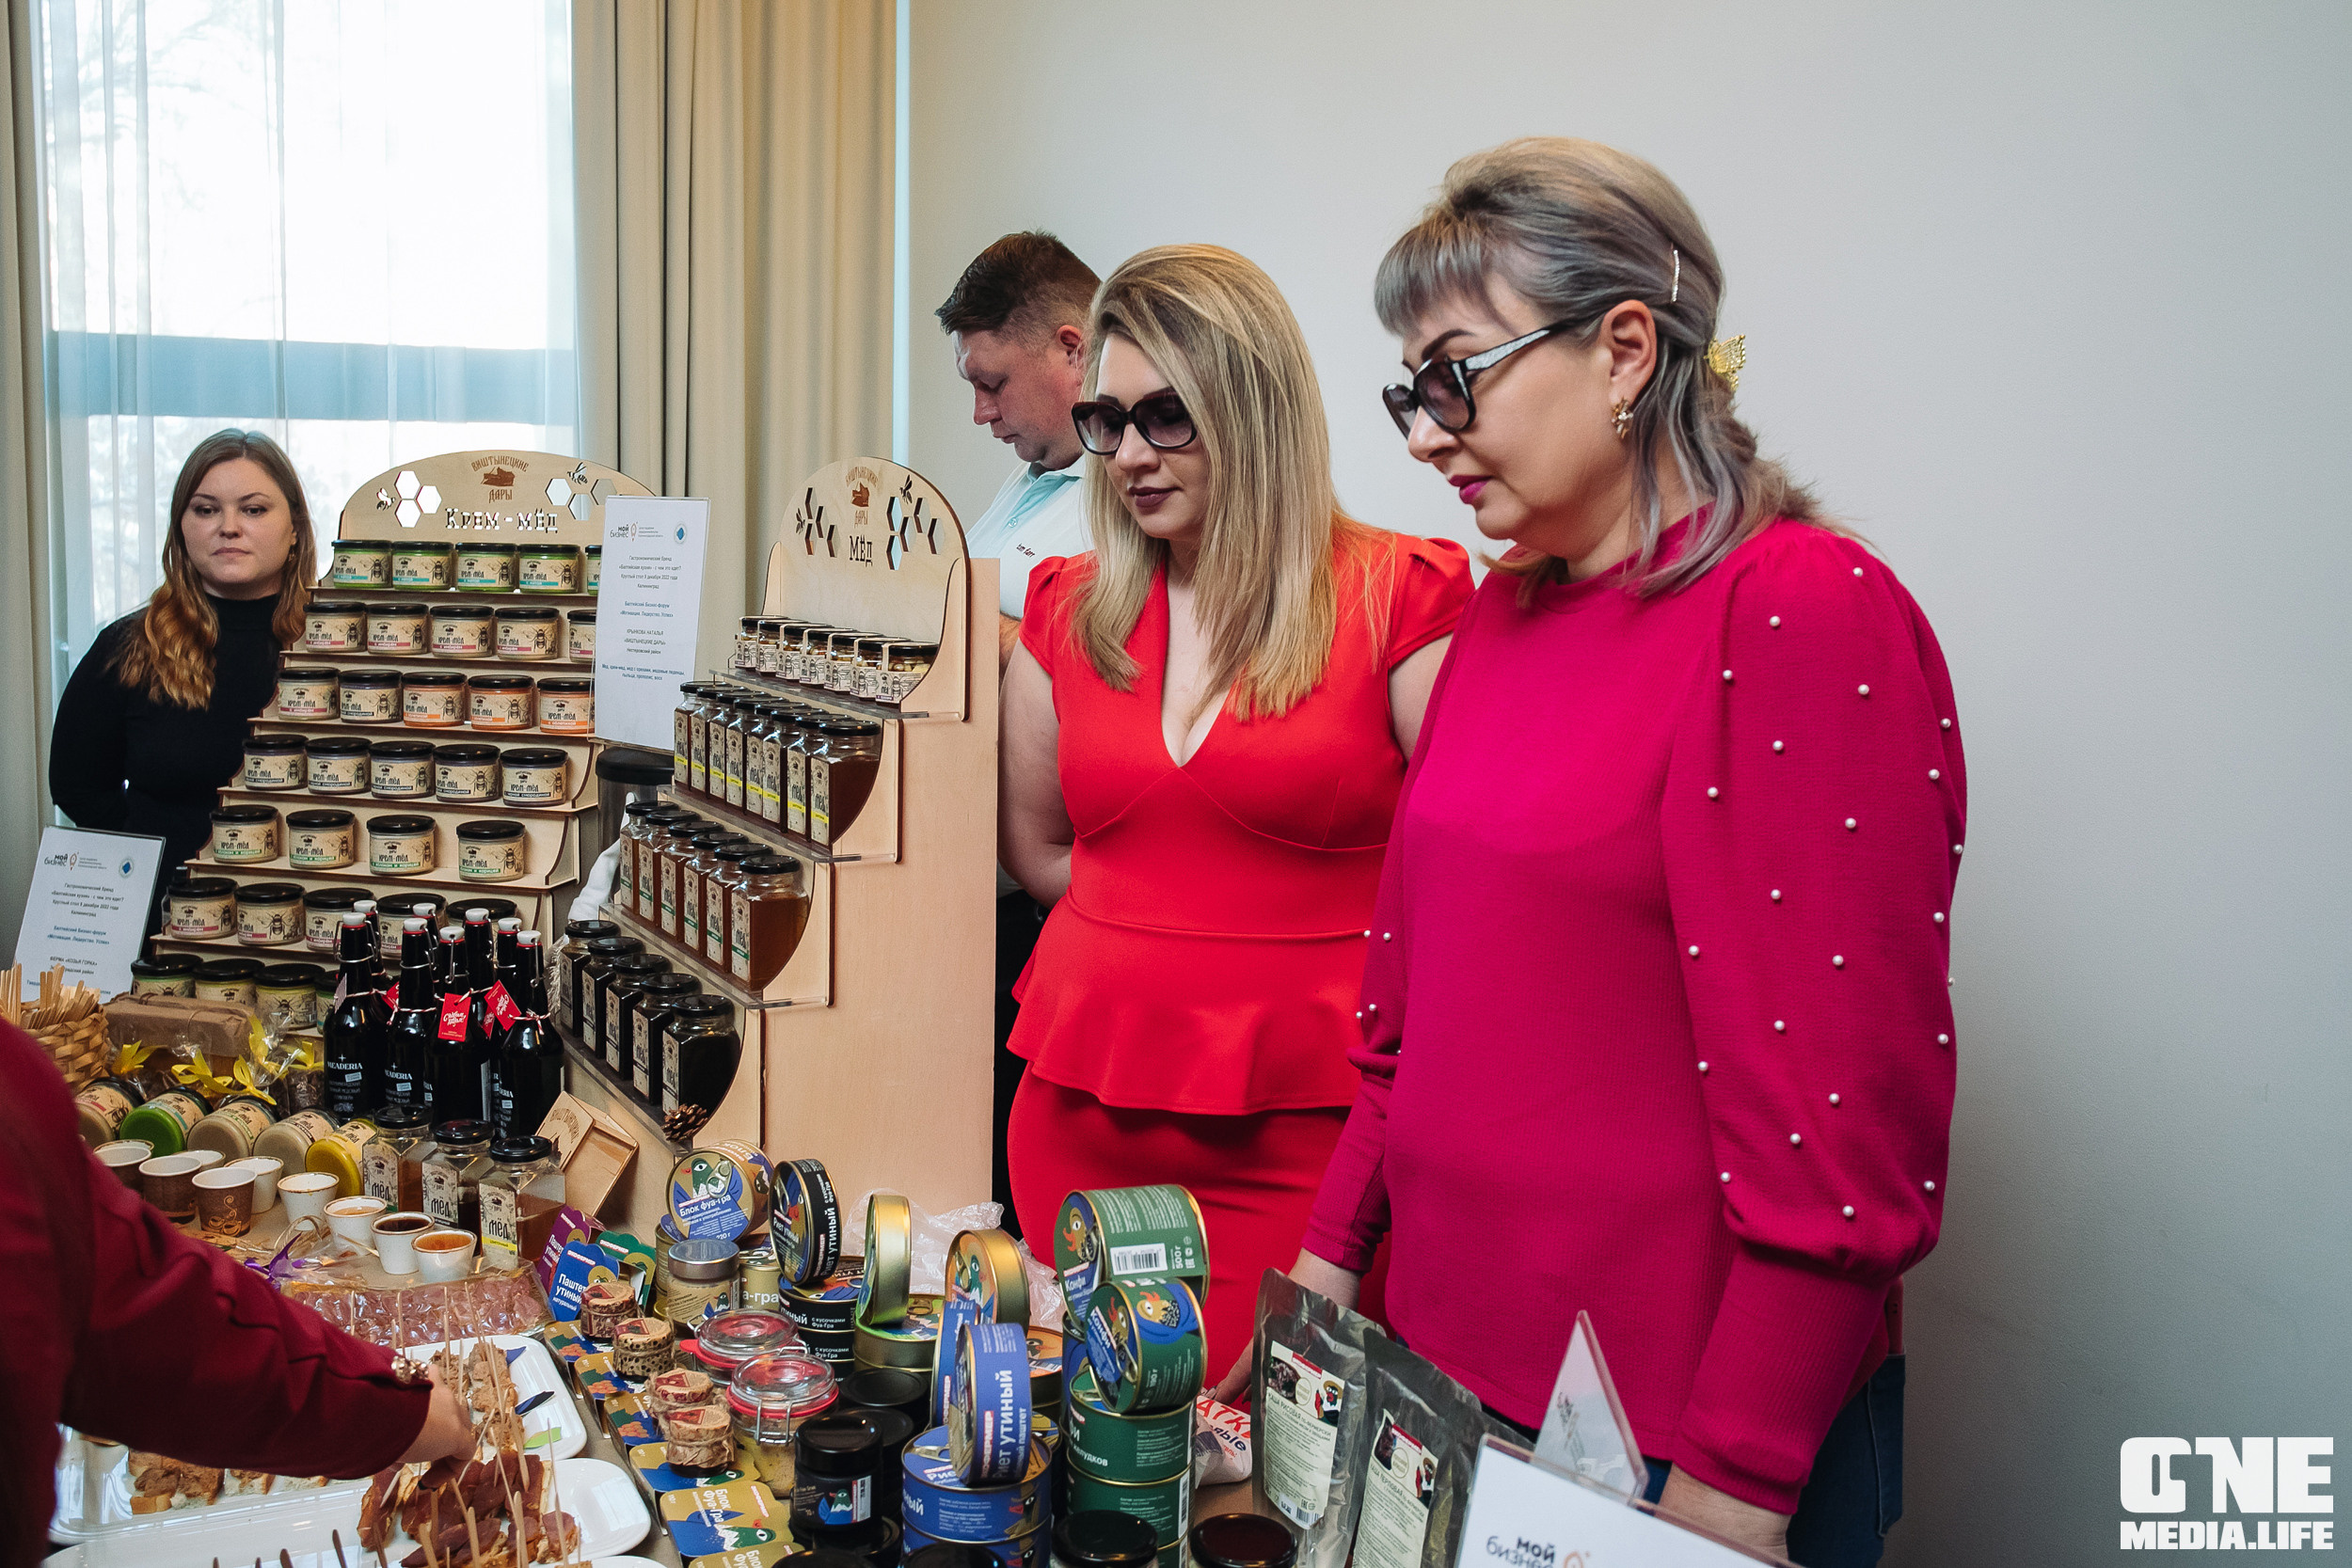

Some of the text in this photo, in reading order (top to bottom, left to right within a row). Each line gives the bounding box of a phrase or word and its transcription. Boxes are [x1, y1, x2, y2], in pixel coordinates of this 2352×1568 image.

[471, 455, 529, 472] ВИШТЫНЕЦКИЕ
[488, 489, 513, 504] ДАРЫ
[680, 1205, 700, 1217] Блок
[489, 1217, 509, 1241] мёд
[1174, 1250, 1184, 1269] 500
[743, 1290, 779, 1305] а-гра
[1090, 1308, 1110, 1349] Конфи
[715, 1489, 732, 1510] Блок
[1517, 1536, 1555, 1564] мой
